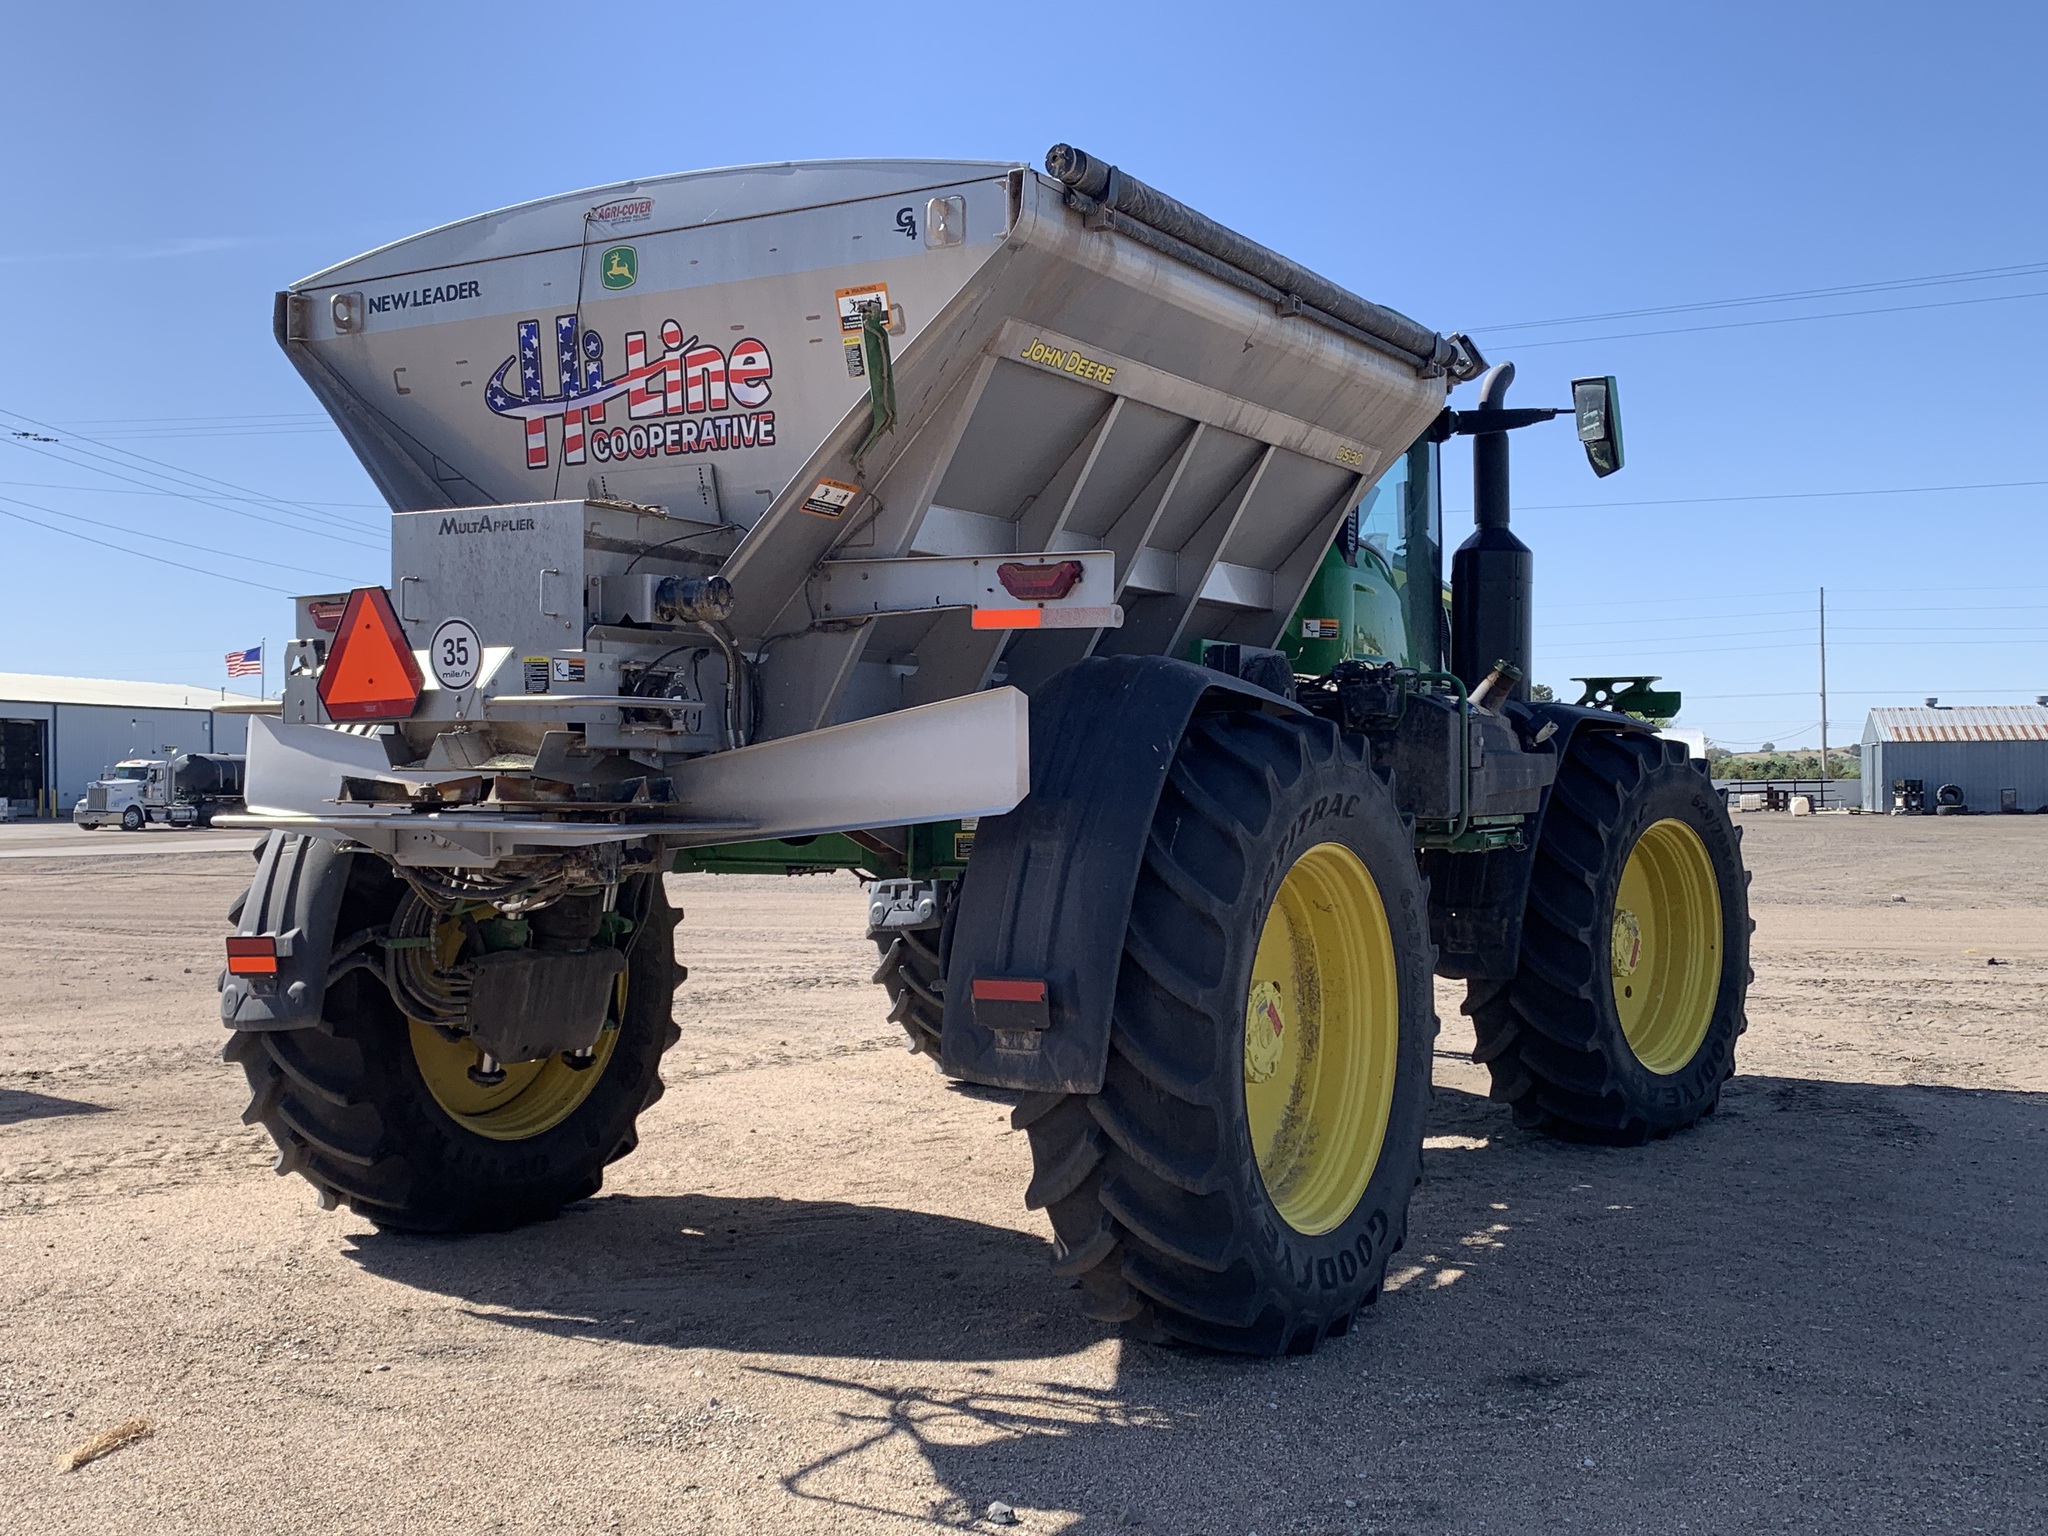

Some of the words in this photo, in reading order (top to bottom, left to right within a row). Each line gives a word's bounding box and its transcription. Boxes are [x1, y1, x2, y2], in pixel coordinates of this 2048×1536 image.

[598, 200, 652, 220] AGRI-COVER
[368, 291, 410, 315] NEW
[411, 280, 481, 307] LEADER
[1021, 337, 1068, 369] JOHN
[1063, 350, 1117, 385] DEERE
[591, 410, 775, 462] COOPERATIVE
[442, 637, 469, 667] 35
[442, 670, 471, 678] mile/h
